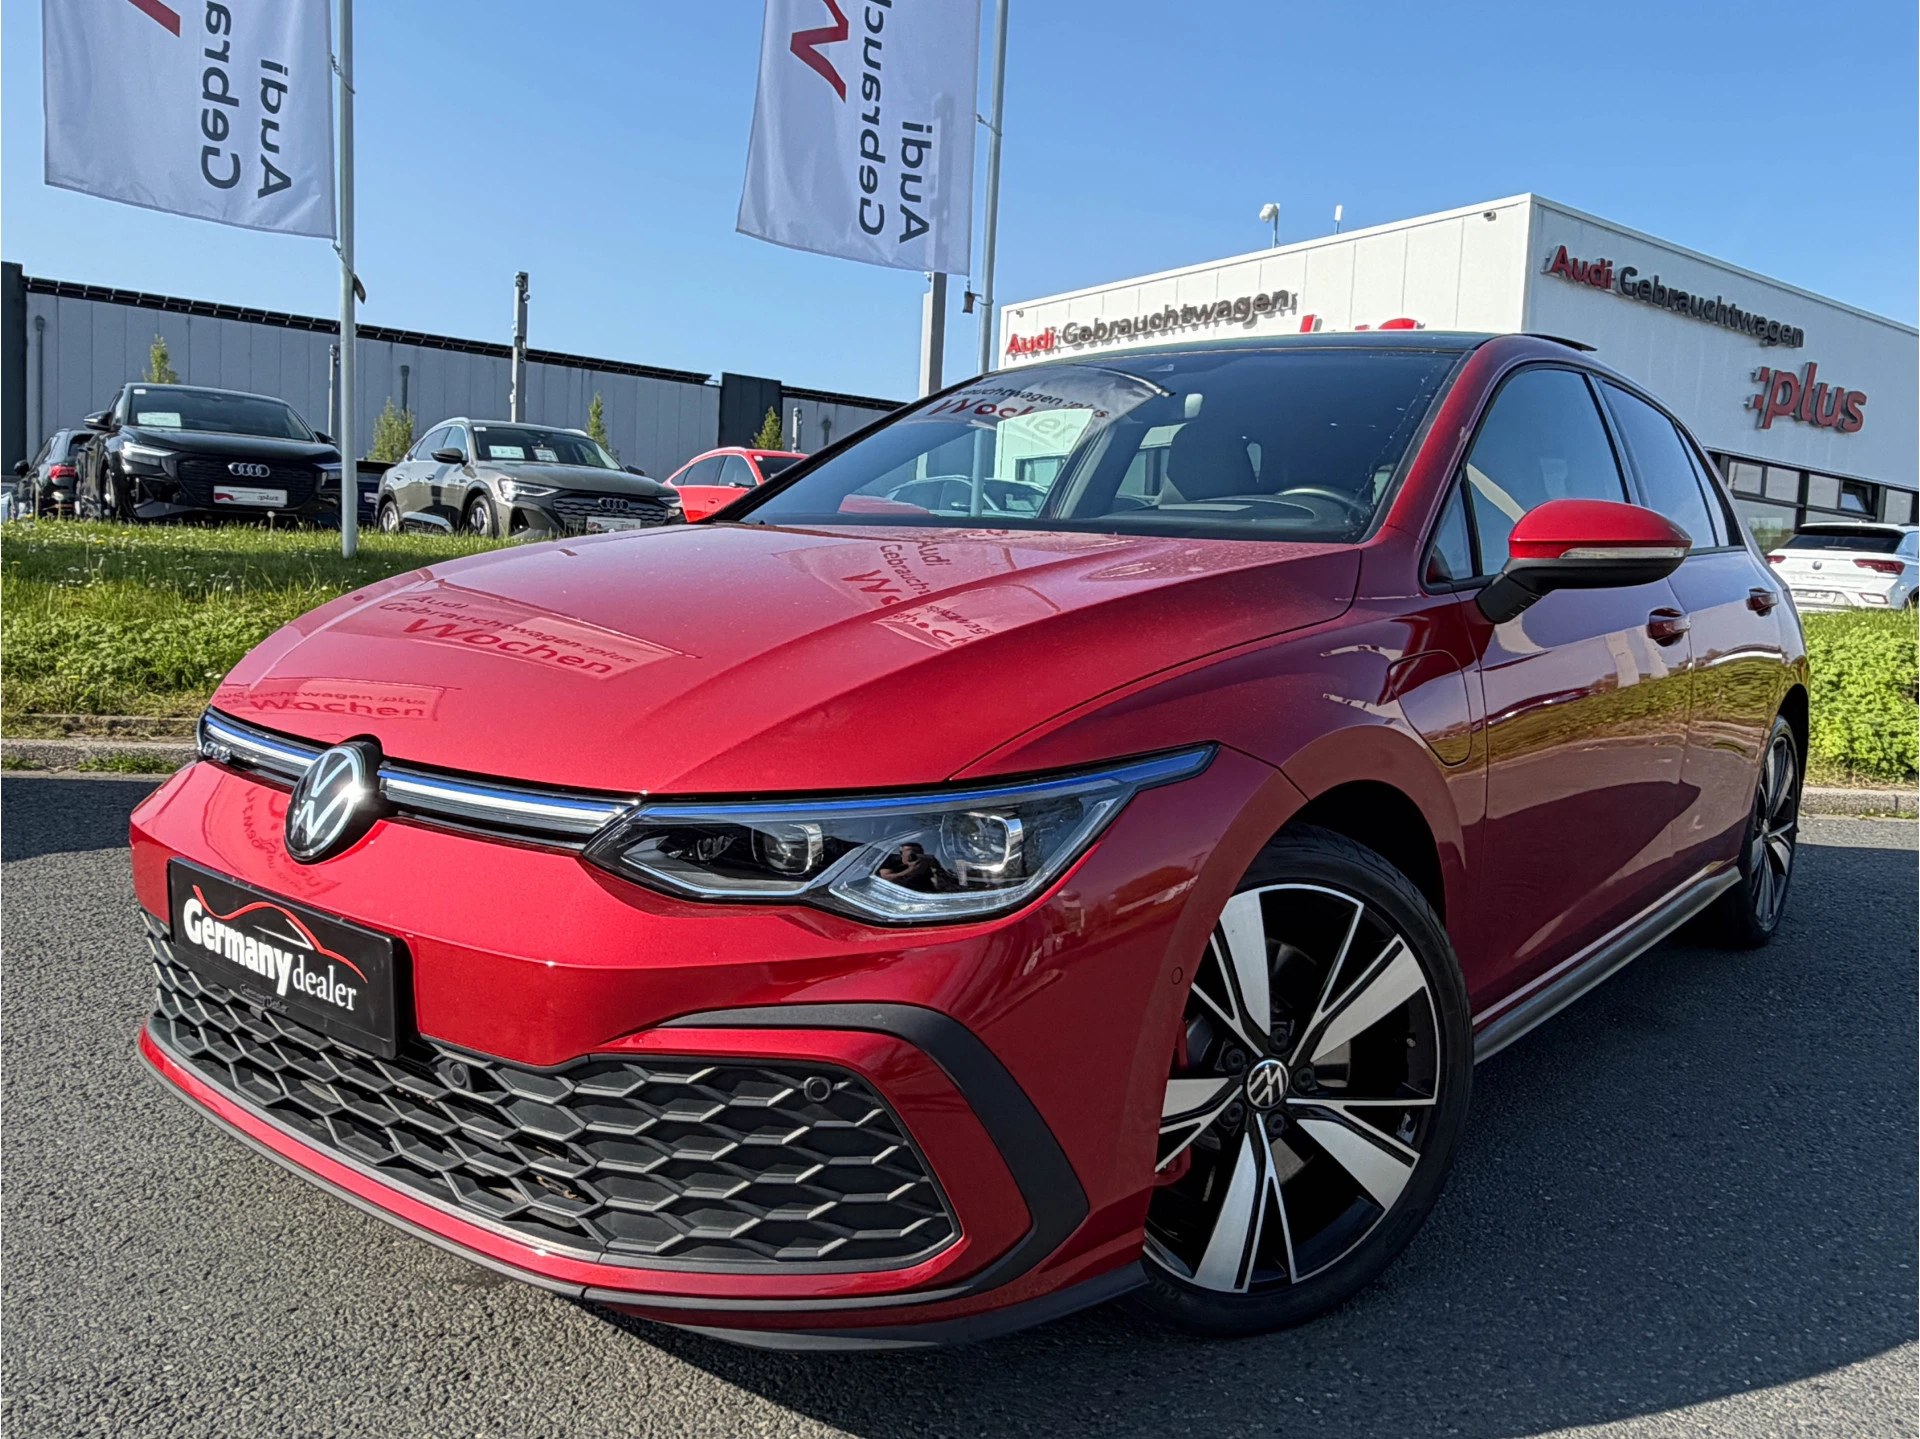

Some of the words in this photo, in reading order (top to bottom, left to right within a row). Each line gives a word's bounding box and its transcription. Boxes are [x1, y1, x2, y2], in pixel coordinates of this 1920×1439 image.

[1005, 326, 1057, 356] Audi
[1061, 289, 1292, 346] Gebrauchtwagen
[1550, 245, 1614, 290] Audi
[1618, 267, 1804, 348] Gebrauchtwagen
[379, 602, 582, 648] Gebrauchtwagen
[405, 595, 469, 610] Audi
[403, 619, 612, 674] Wochen
[250, 699, 424, 716] Wochen
[183, 898, 293, 996] Germany
[292, 955, 356, 1011] dealer
